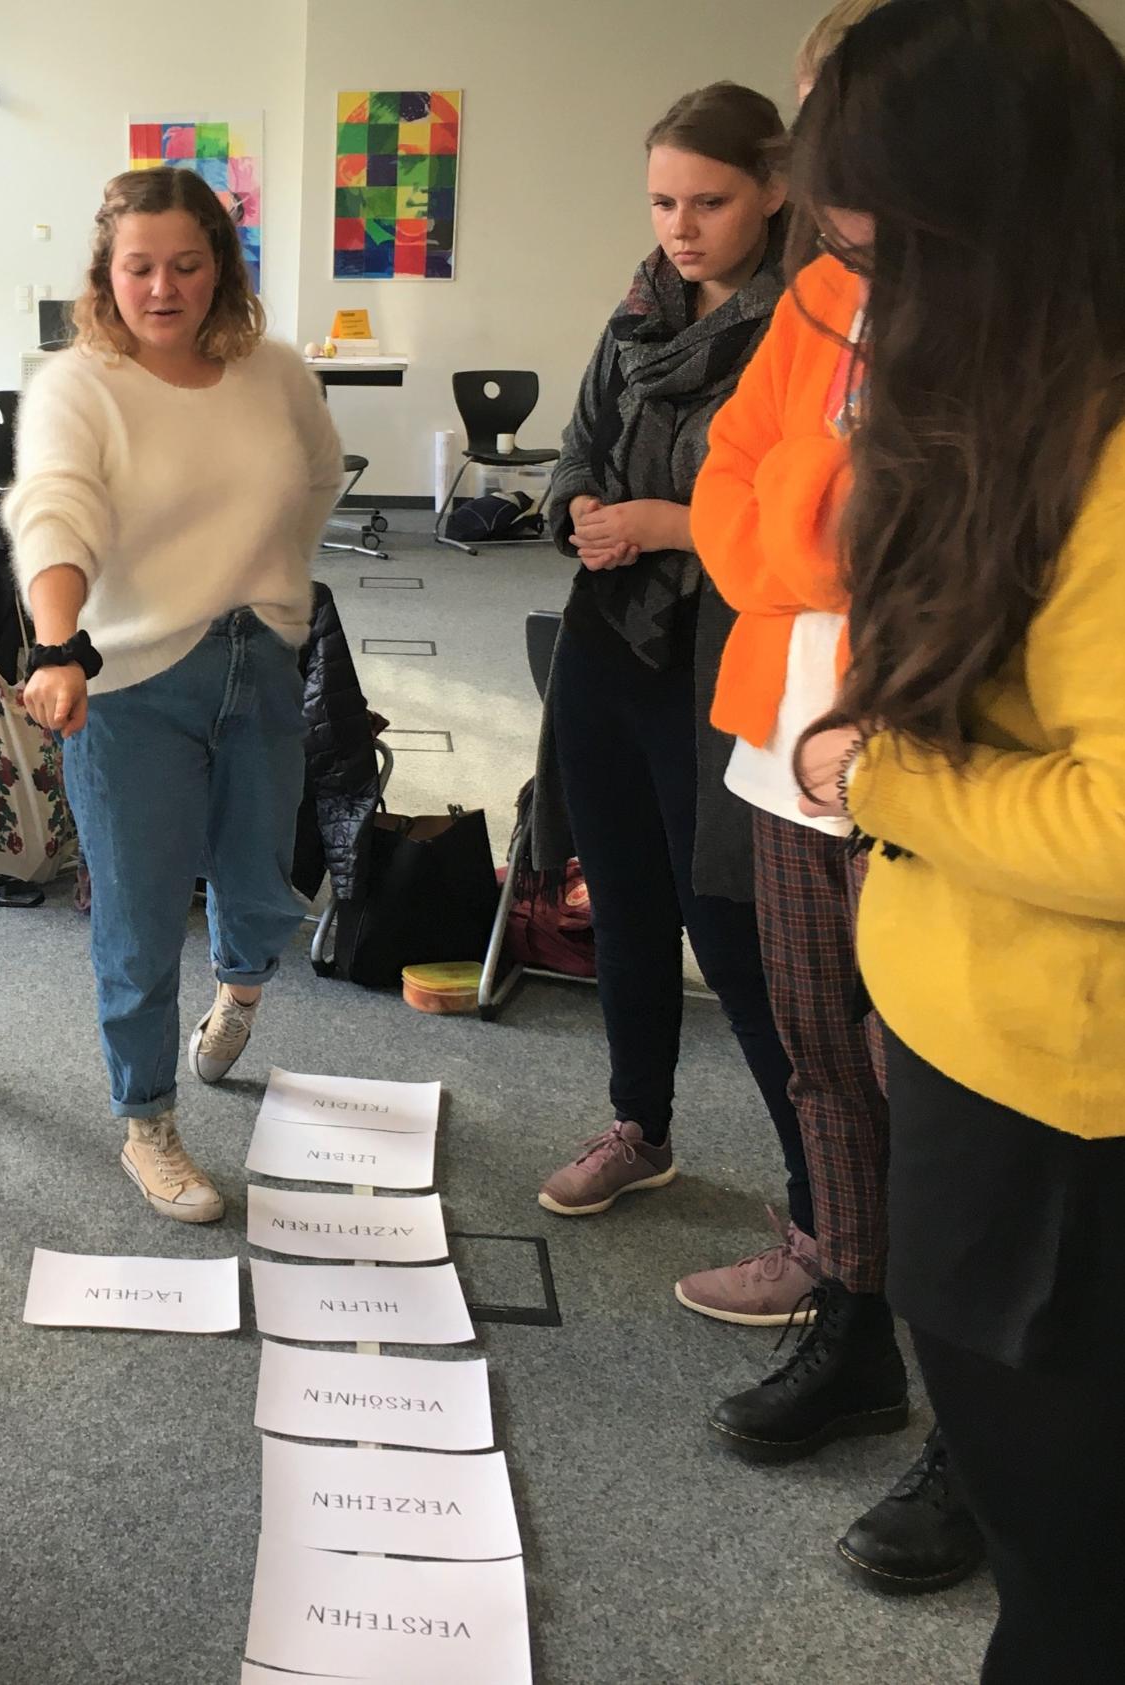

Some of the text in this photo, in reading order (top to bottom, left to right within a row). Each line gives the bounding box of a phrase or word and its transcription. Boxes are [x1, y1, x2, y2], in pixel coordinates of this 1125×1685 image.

[312, 1099, 389, 1113] FRIEDEN
[306, 1150, 376, 1165] LIEBEN
[271, 1217, 414, 1237] AKZEPTIEREN
[84, 1287, 183, 1304] LÄCHELN
[319, 1299, 398, 1314] HELFEN
[303, 1388, 444, 1412] VERSÖHNEN
[312, 1491, 462, 1516] VERZEIHEN
[306, 1604, 471, 1640] VERSTEHEN
